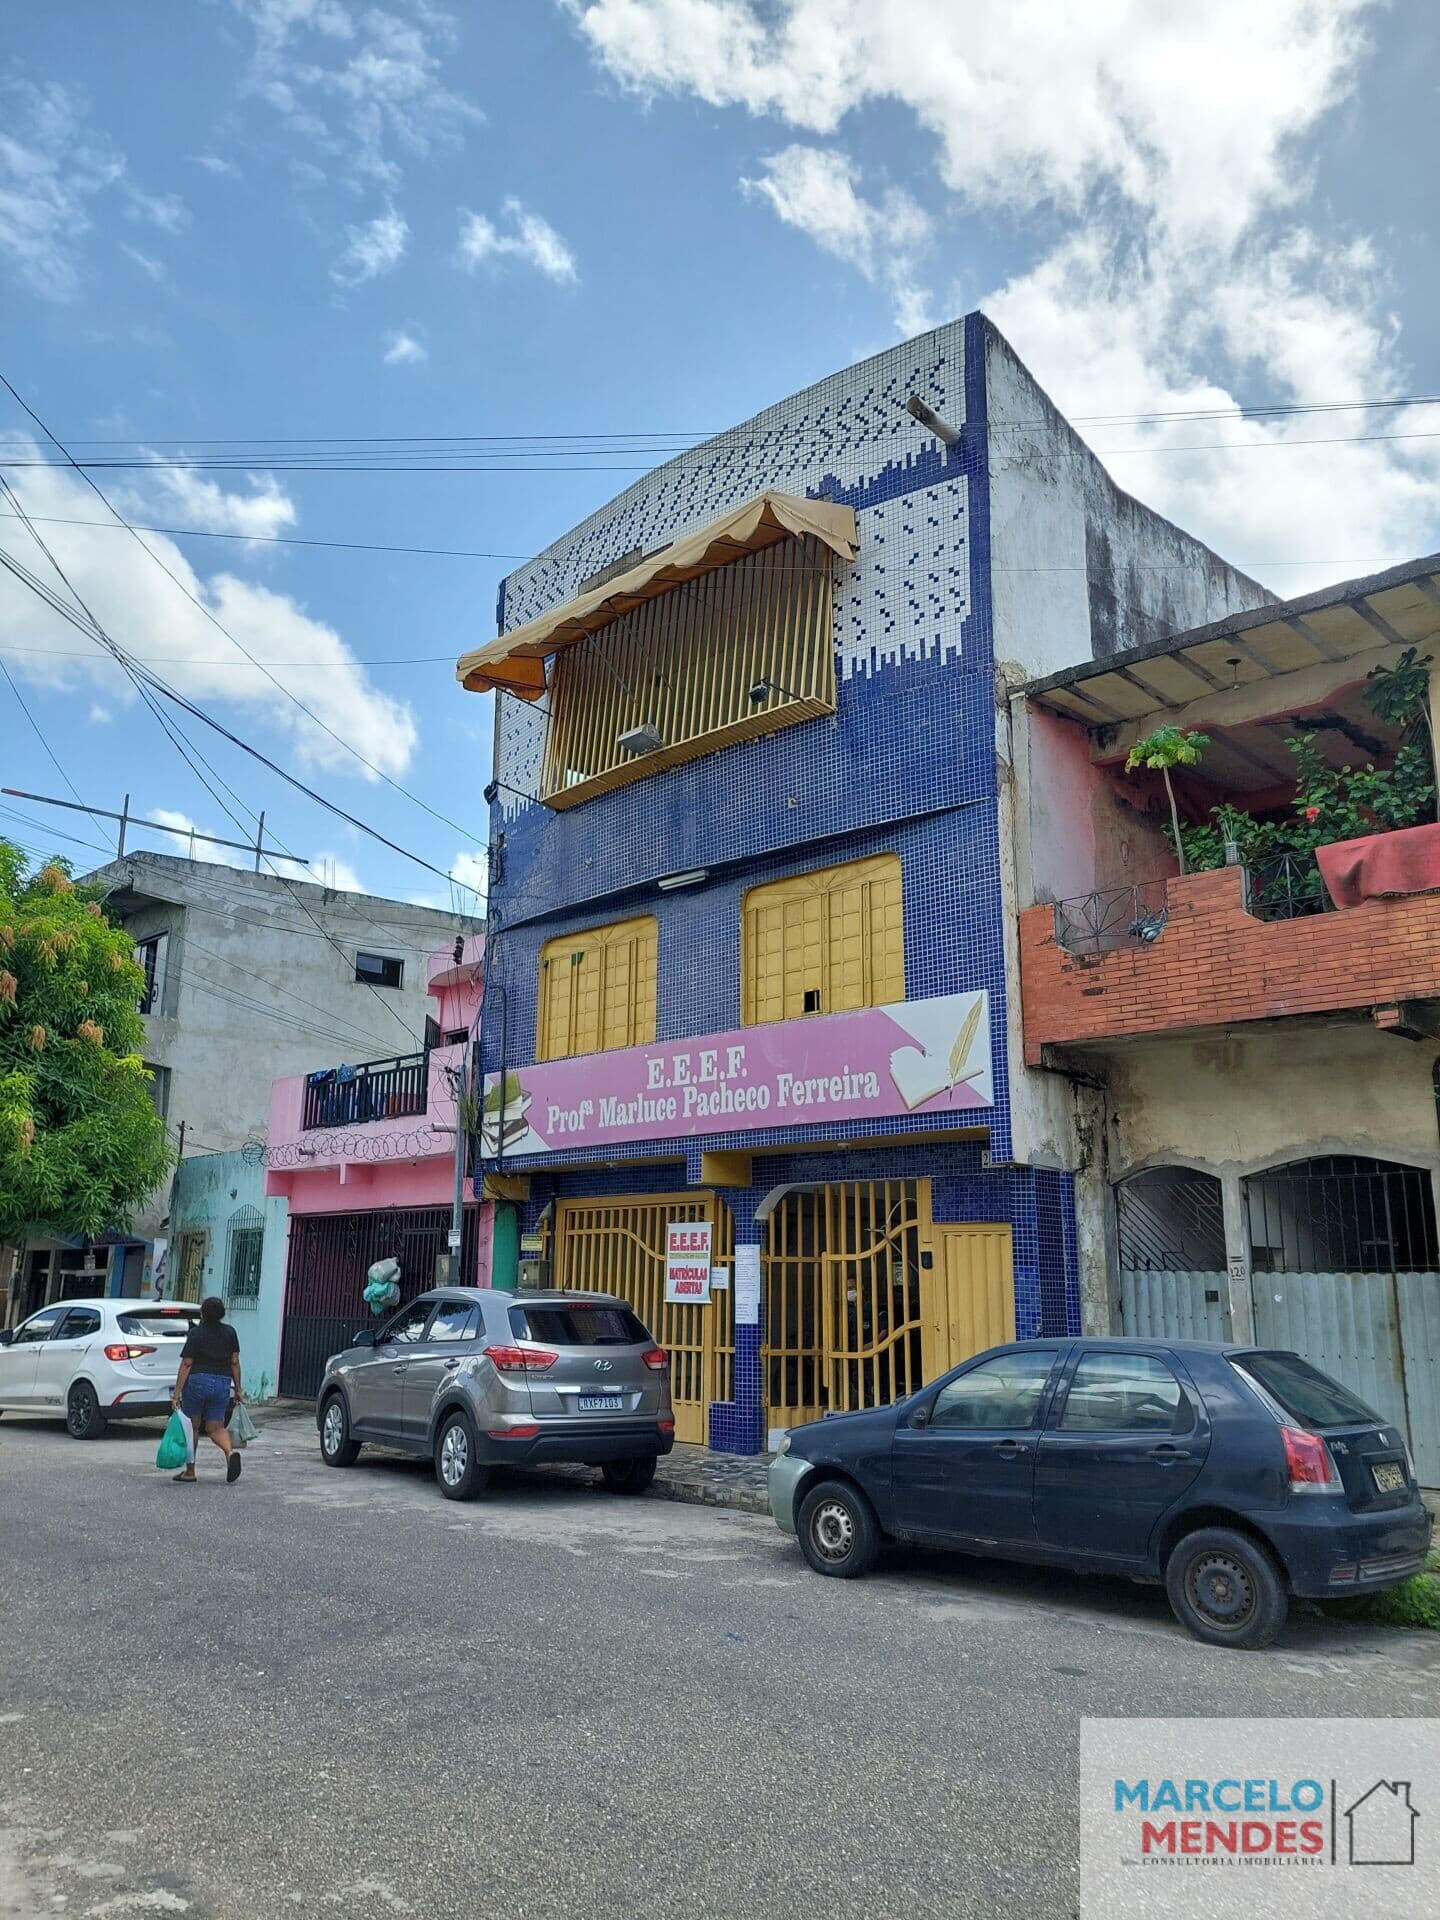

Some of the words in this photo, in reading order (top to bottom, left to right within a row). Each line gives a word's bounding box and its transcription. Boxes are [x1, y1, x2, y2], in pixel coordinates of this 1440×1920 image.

[646, 1046, 747, 1089] E.E.E.F.
[598, 1093, 677, 1128] Marluce
[682, 1082, 769, 1117] Pacheco
[777, 1065, 880, 1107] Ferreira
[669, 1232, 709, 1251] E.E.E.F.
